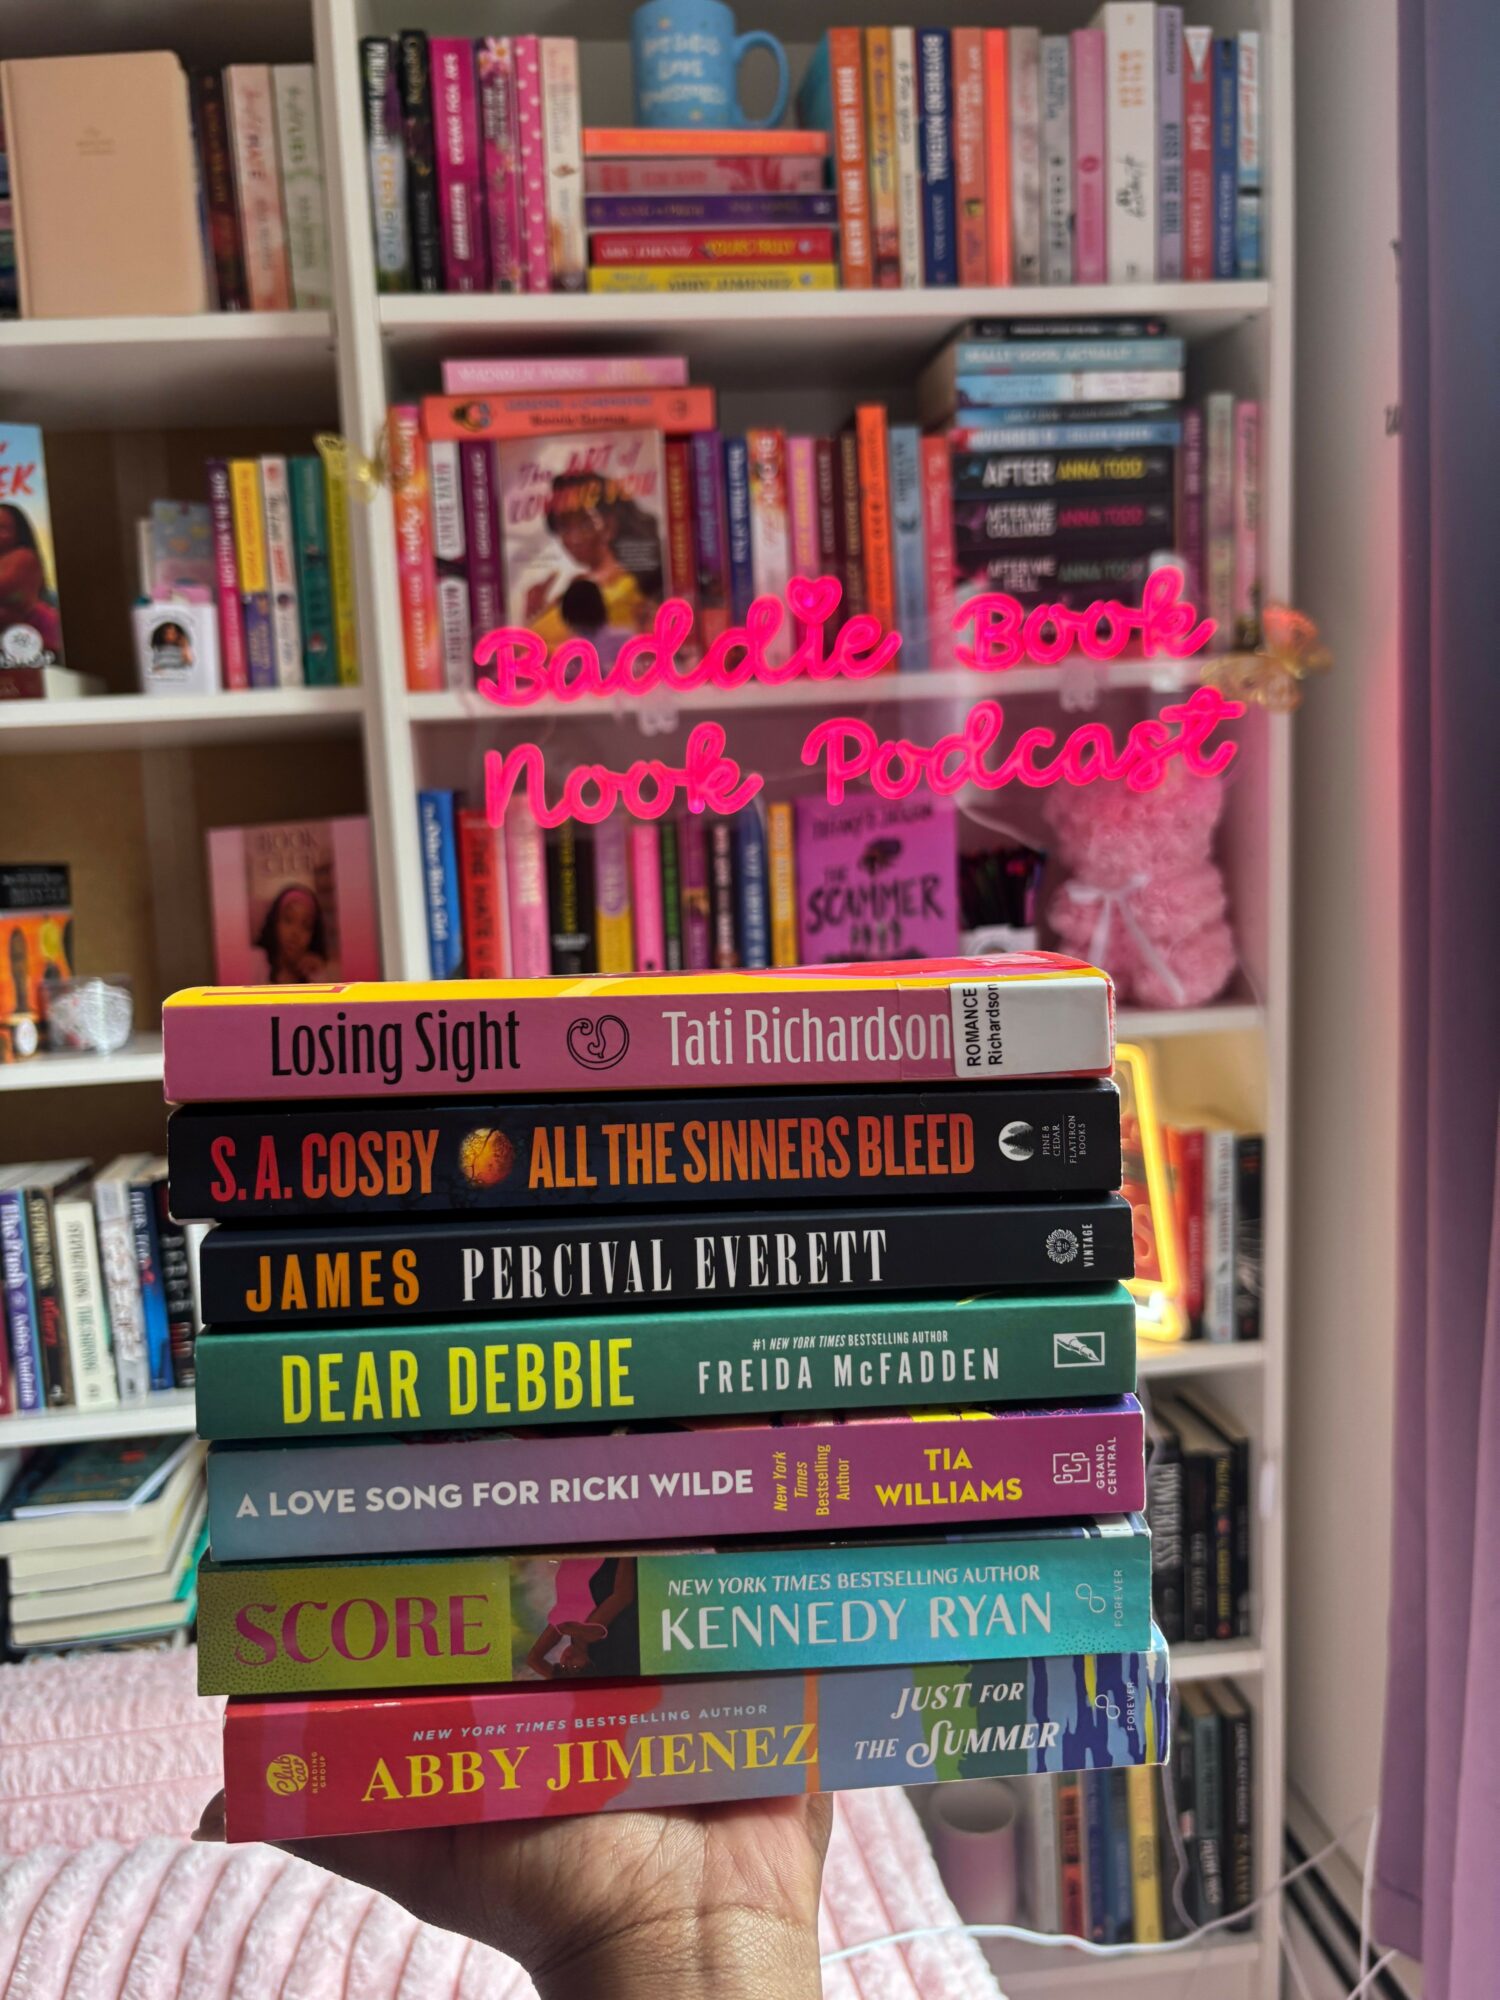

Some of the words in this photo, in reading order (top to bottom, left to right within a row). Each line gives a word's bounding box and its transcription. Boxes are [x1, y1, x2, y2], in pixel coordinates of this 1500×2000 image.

[921, 34, 946, 113] BOYFRIEND
[925, 115, 948, 185] MATERIAL
[982, 457, 1055, 488] AFTER
[1056, 458, 1100, 480] ANNA
[1104, 456, 1148, 479] TODD
[473, 576, 902, 707] Baddie
[951, 565, 1219, 672] Book
[801, 686, 1246, 805] Podcast
[806, 873, 944, 935] SCAMMER
[271, 1012, 401, 1085] Losing
[415, 1009, 521, 1084] Sight
[662, 1008, 733, 1066] Tati
[745, 1007, 951, 1066] Richardson
[965, 986, 982, 1067] ROMANCE
[987, 983, 1004, 1066] Richardson
[528, 1125, 597, 1189] ALL
[602, 1122, 675, 1186] THE
[682, 1115, 851, 1185] SINNERS
[859, 1112, 975, 1177] BLEED
[1042, 1132, 1050, 1155] PINE
[1052, 1123, 1061, 1157] CEDAR
[1068, 1115, 1077, 1164] FLATIRON
[1078, 1122, 1086, 1155] BOOKS
[301, 1129, 439, 1199] COSBY
[461, 1238, 672, 1302] PERCIVAL
[695, 1229, 887, 1291] EVERETT
[1082, 1223, 1094, 1267] VINTAGE
[245, 1248, 420, 1313] JAMES
[752, 1338, 767, 1351] #1
[769, 1337, 789, 1351] NEW
[790, 1335, 817, 1349] YORK
[818, 1334, 847, 1348] TIMES
[848, 1331, 909, 1347] BESTSELLING
[911, 1330, 949, 1344] AUTHOR
[282, 1349, 421, 1425] DEAR
[448, 1338, 635, 1417] DEBBIE
[698, 1356, 813, 1394] FREIDA
[833, 1347, 999, 1388] McFADDEN
[773, 1451, 787, 1480] York
[794, 1460, 808, 1498] Times
[815, 1444, 831, 1516] Bestselling
[835, 1457, 850, 1501] Author
[923, 1447, 973, 1471] TIA
[1096, 1443, 1105, 1490] GRAND
[1107, 1436, 1117, 1495] CENTRAL
[236, 1494, 260, 1518] A
[269, 1488, 355, 1516] LOVE
[365, 1483, 463, 1512] SONG
[472, 1480, 540, 1507] FOR
[549, 1474, 639, 1503] RICKI
[649, 1469, 753, 1497] WILDE
[773, 1482, 788, 1512] New
[875, 1478, 1023, 1507] WILLIAMS
[668, 1577, 714, 1597] NEW
[717, 1575, 768, 1594] YORK
[772, 1573, 831, 1593] TIMES
[837, 1567, 959, 1589] BESTSELLING
[962, 1564, 1041, 1584] AUTHOR
[1114, 1568, 1125, 1628] FOREVER
[234, 1594, 491, 1667] SCORE
[660, 1597, 908, 1653] KENNEDY
[929, 1591, 1052, 1639] RYAN
[412, 1728, 453, 1743] NEW
[460, 1723, 508, 1738] YORK
[514, 1720, 567, 1734] TIMES
[574, 1710, 691, 1729] BESTSELLING
[698, 1704, 768, 1720] AUTHOR
[890, 1683, 973, 1719] JUST
[978, 1681, 1025, 1704] FOR
[1126, 1681, 1137, 1731] FOREVER
[361, 1745, 530, 1804] ABBY
[545, 1722, 819, 1792] JIMENEZ
[854, 1738, 899, 1761] THE
[905, 1720, 1060, 1769] SUMMER
[272, 1755, 299, 1794] Club
[311, 1751, 319, 1794] READING
[319, 1755, 327, 1788] GROUP
